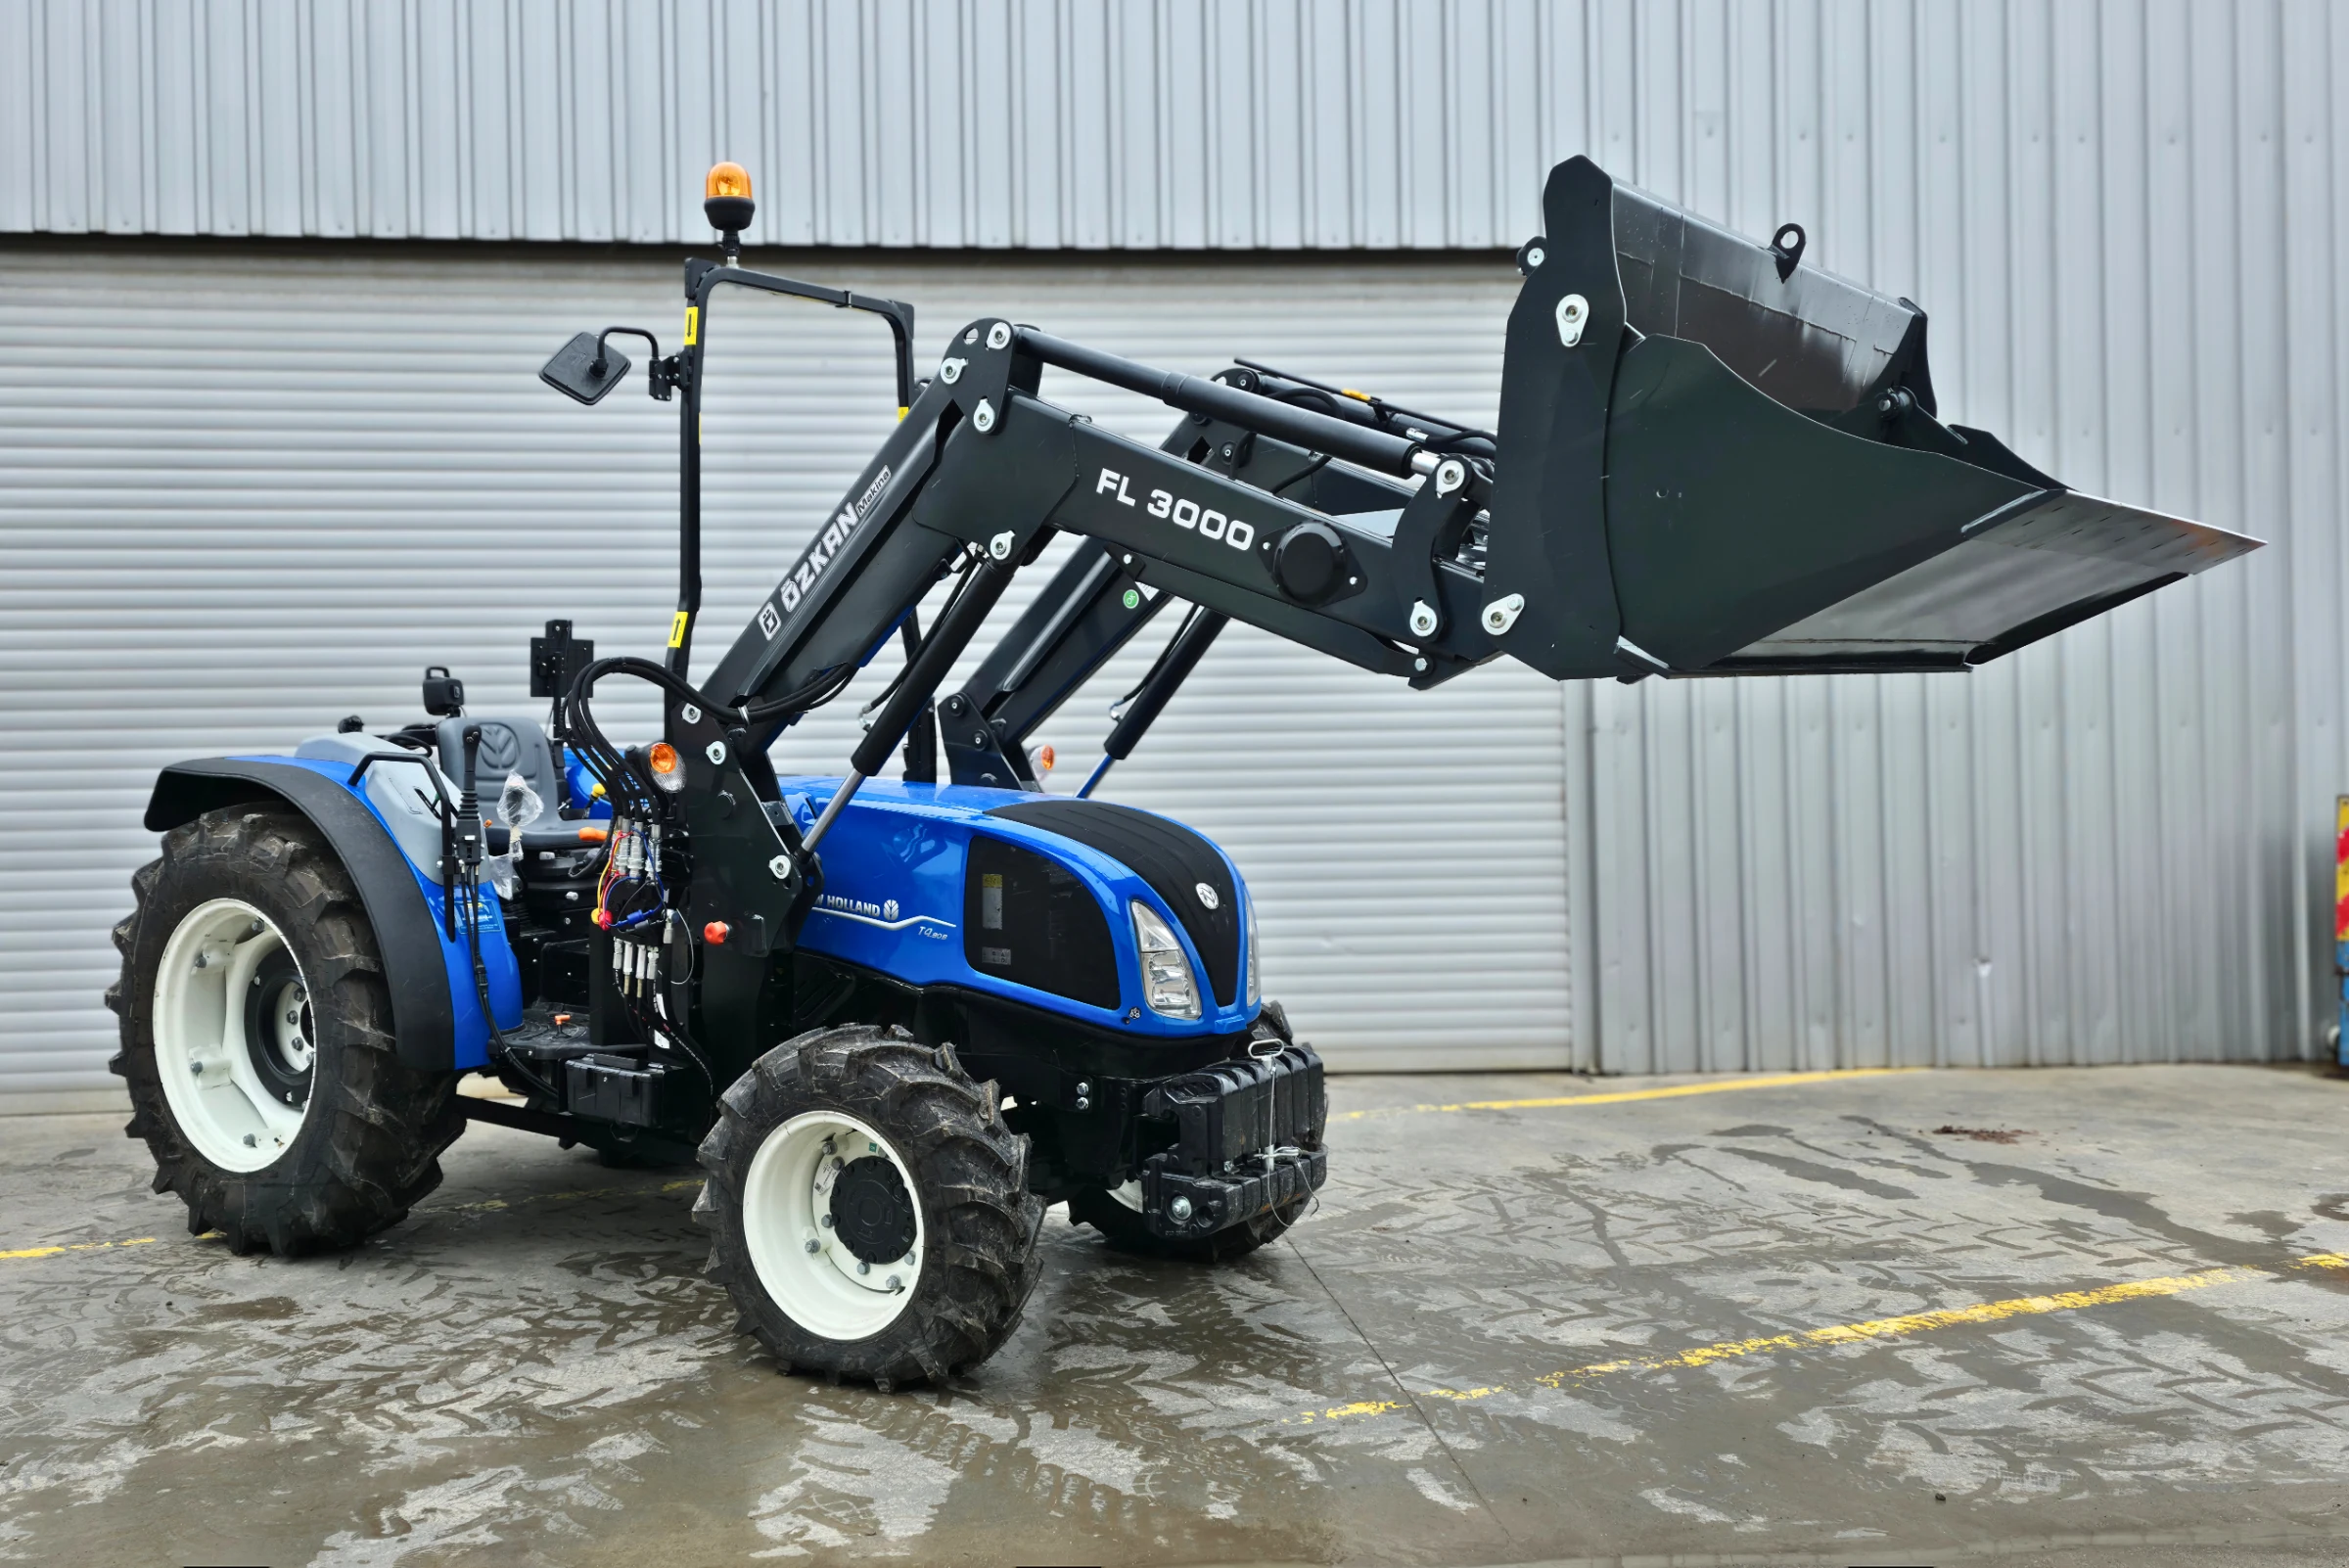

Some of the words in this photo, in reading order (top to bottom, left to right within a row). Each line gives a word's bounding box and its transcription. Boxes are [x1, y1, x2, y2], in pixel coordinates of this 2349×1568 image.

[1095, 467, 1136, 507] FL
[1147, 488, 1255, 551] 3000
[781, 502, 858, 613] ÖZKAN
[857, 470, 890, 514] Makina
[1126, 592, 1136, 605] OK
[827, 895, 881, 917] HOLLAND
